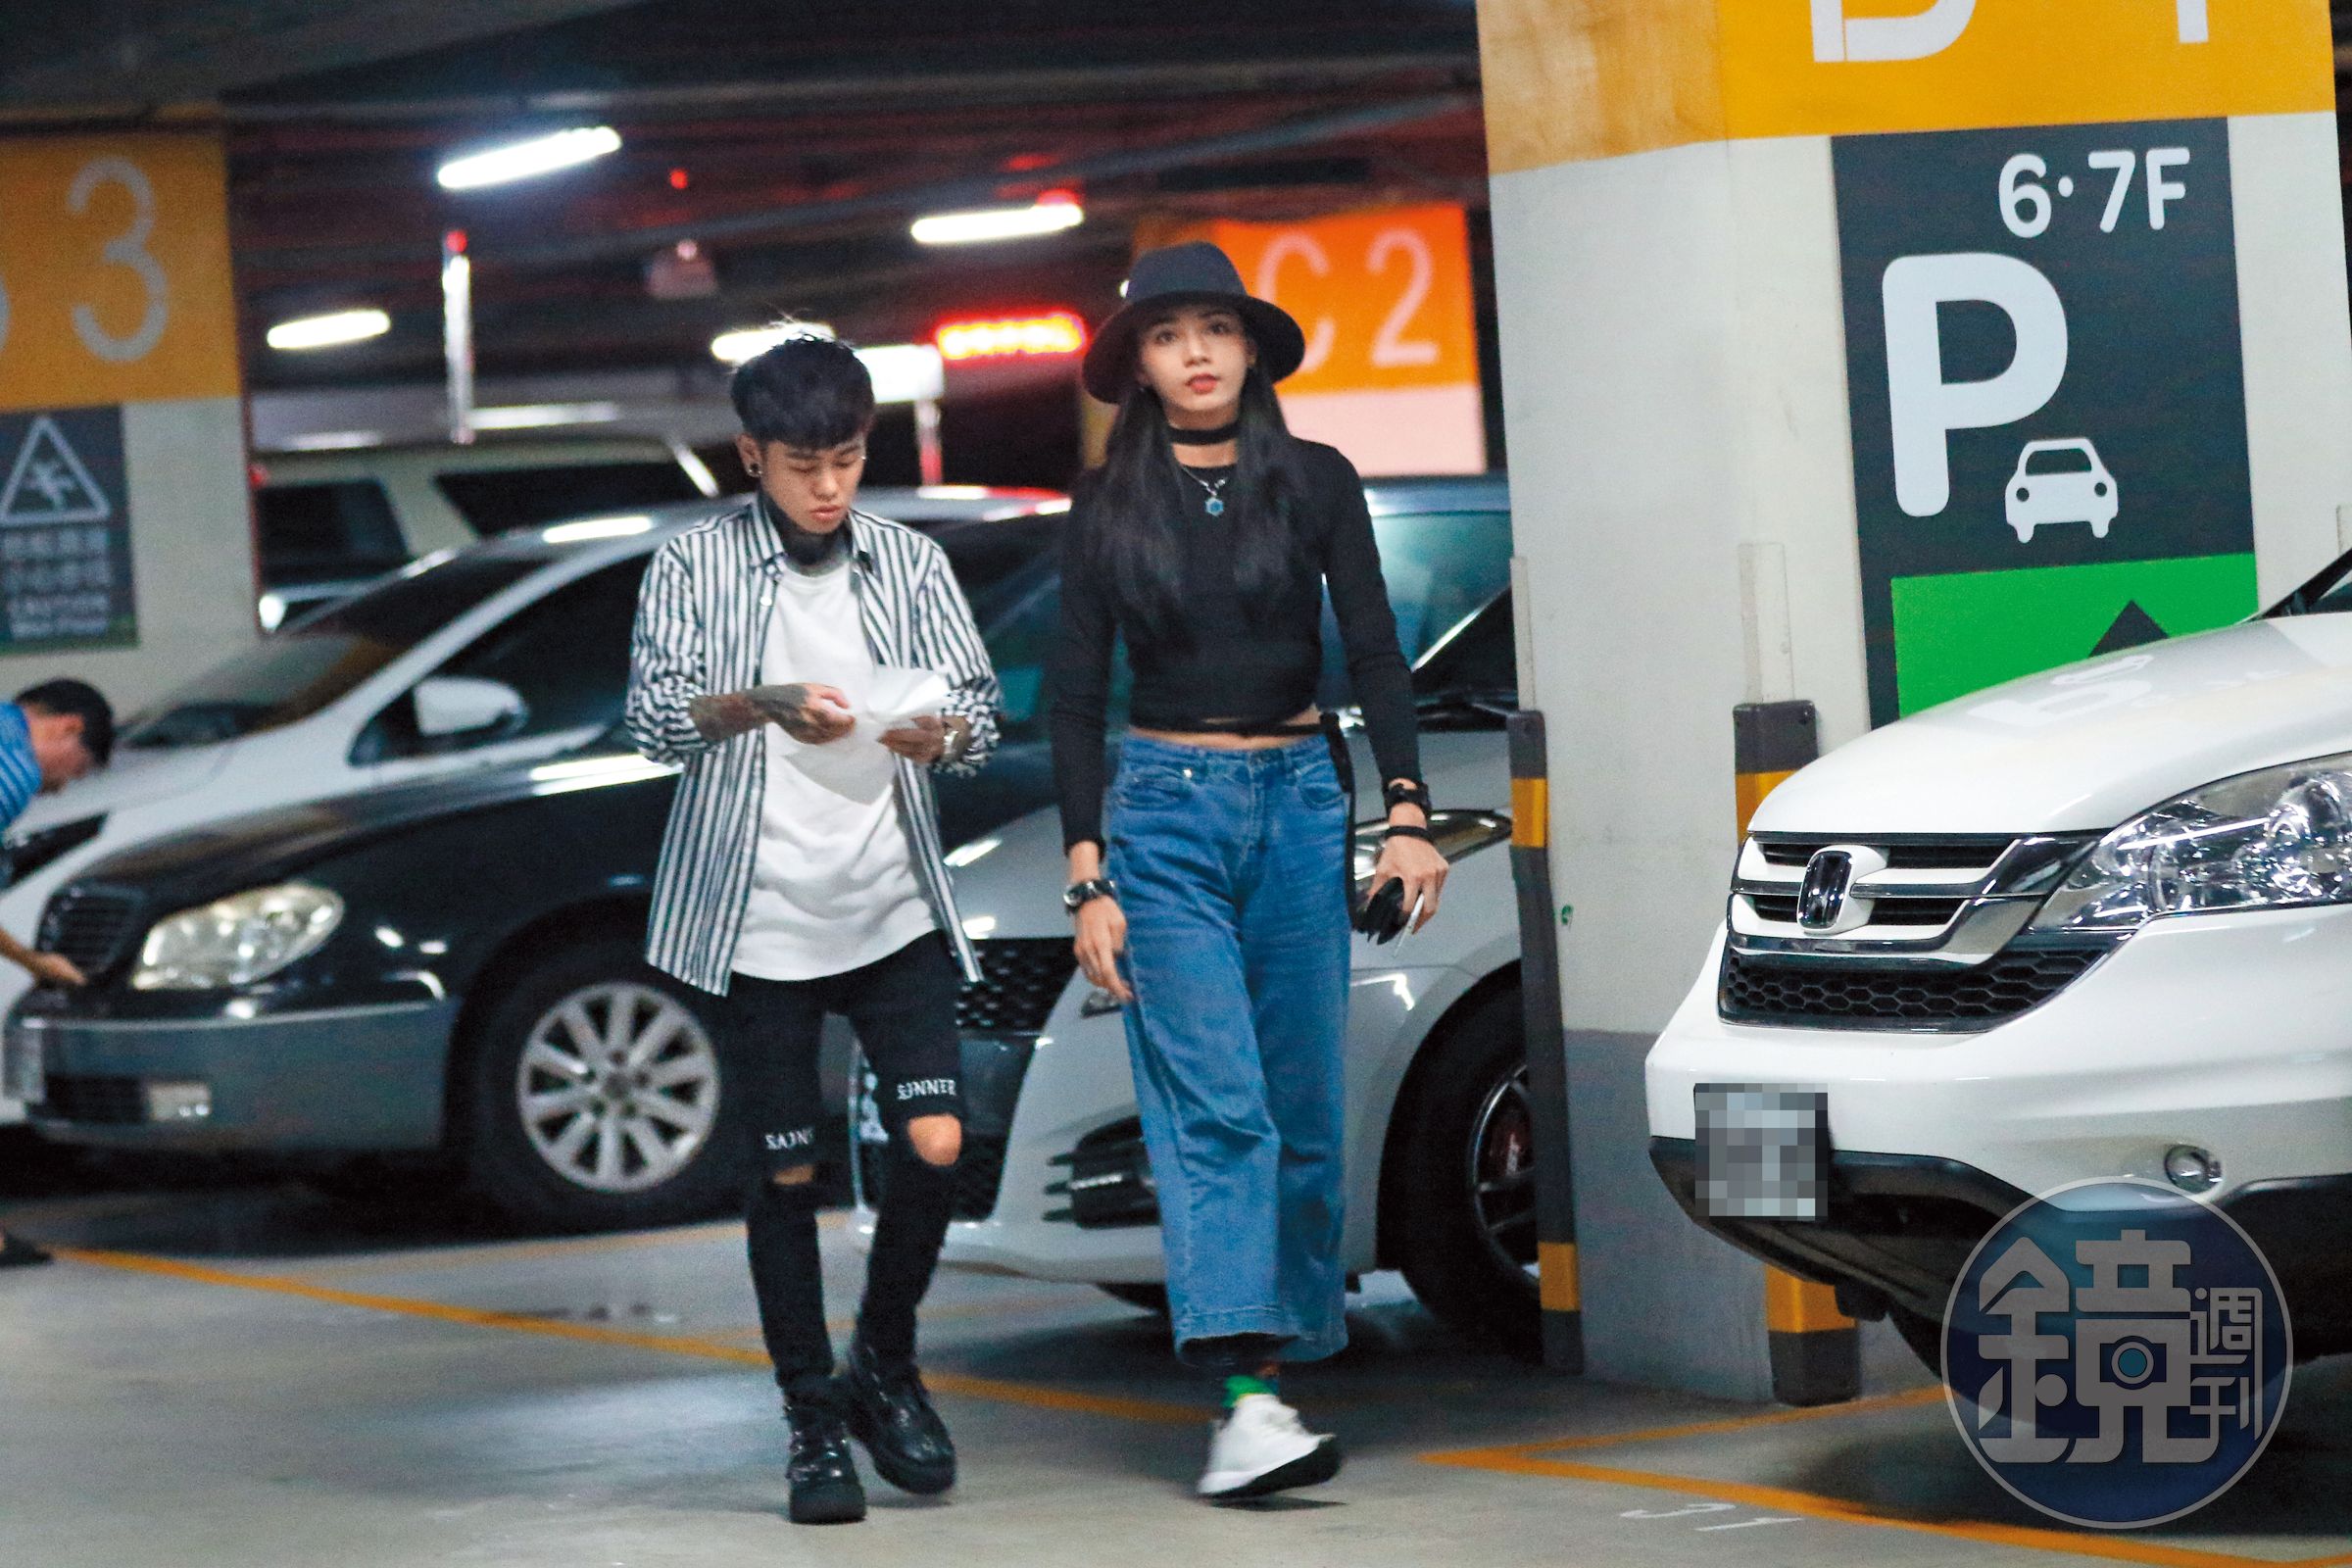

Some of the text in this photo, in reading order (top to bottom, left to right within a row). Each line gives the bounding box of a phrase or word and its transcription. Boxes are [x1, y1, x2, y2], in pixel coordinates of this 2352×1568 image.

[68, 157, 170, 363] 3
[1882, 251, 2069, 517] P
[897, 1078, 957, 1101] SINNER
